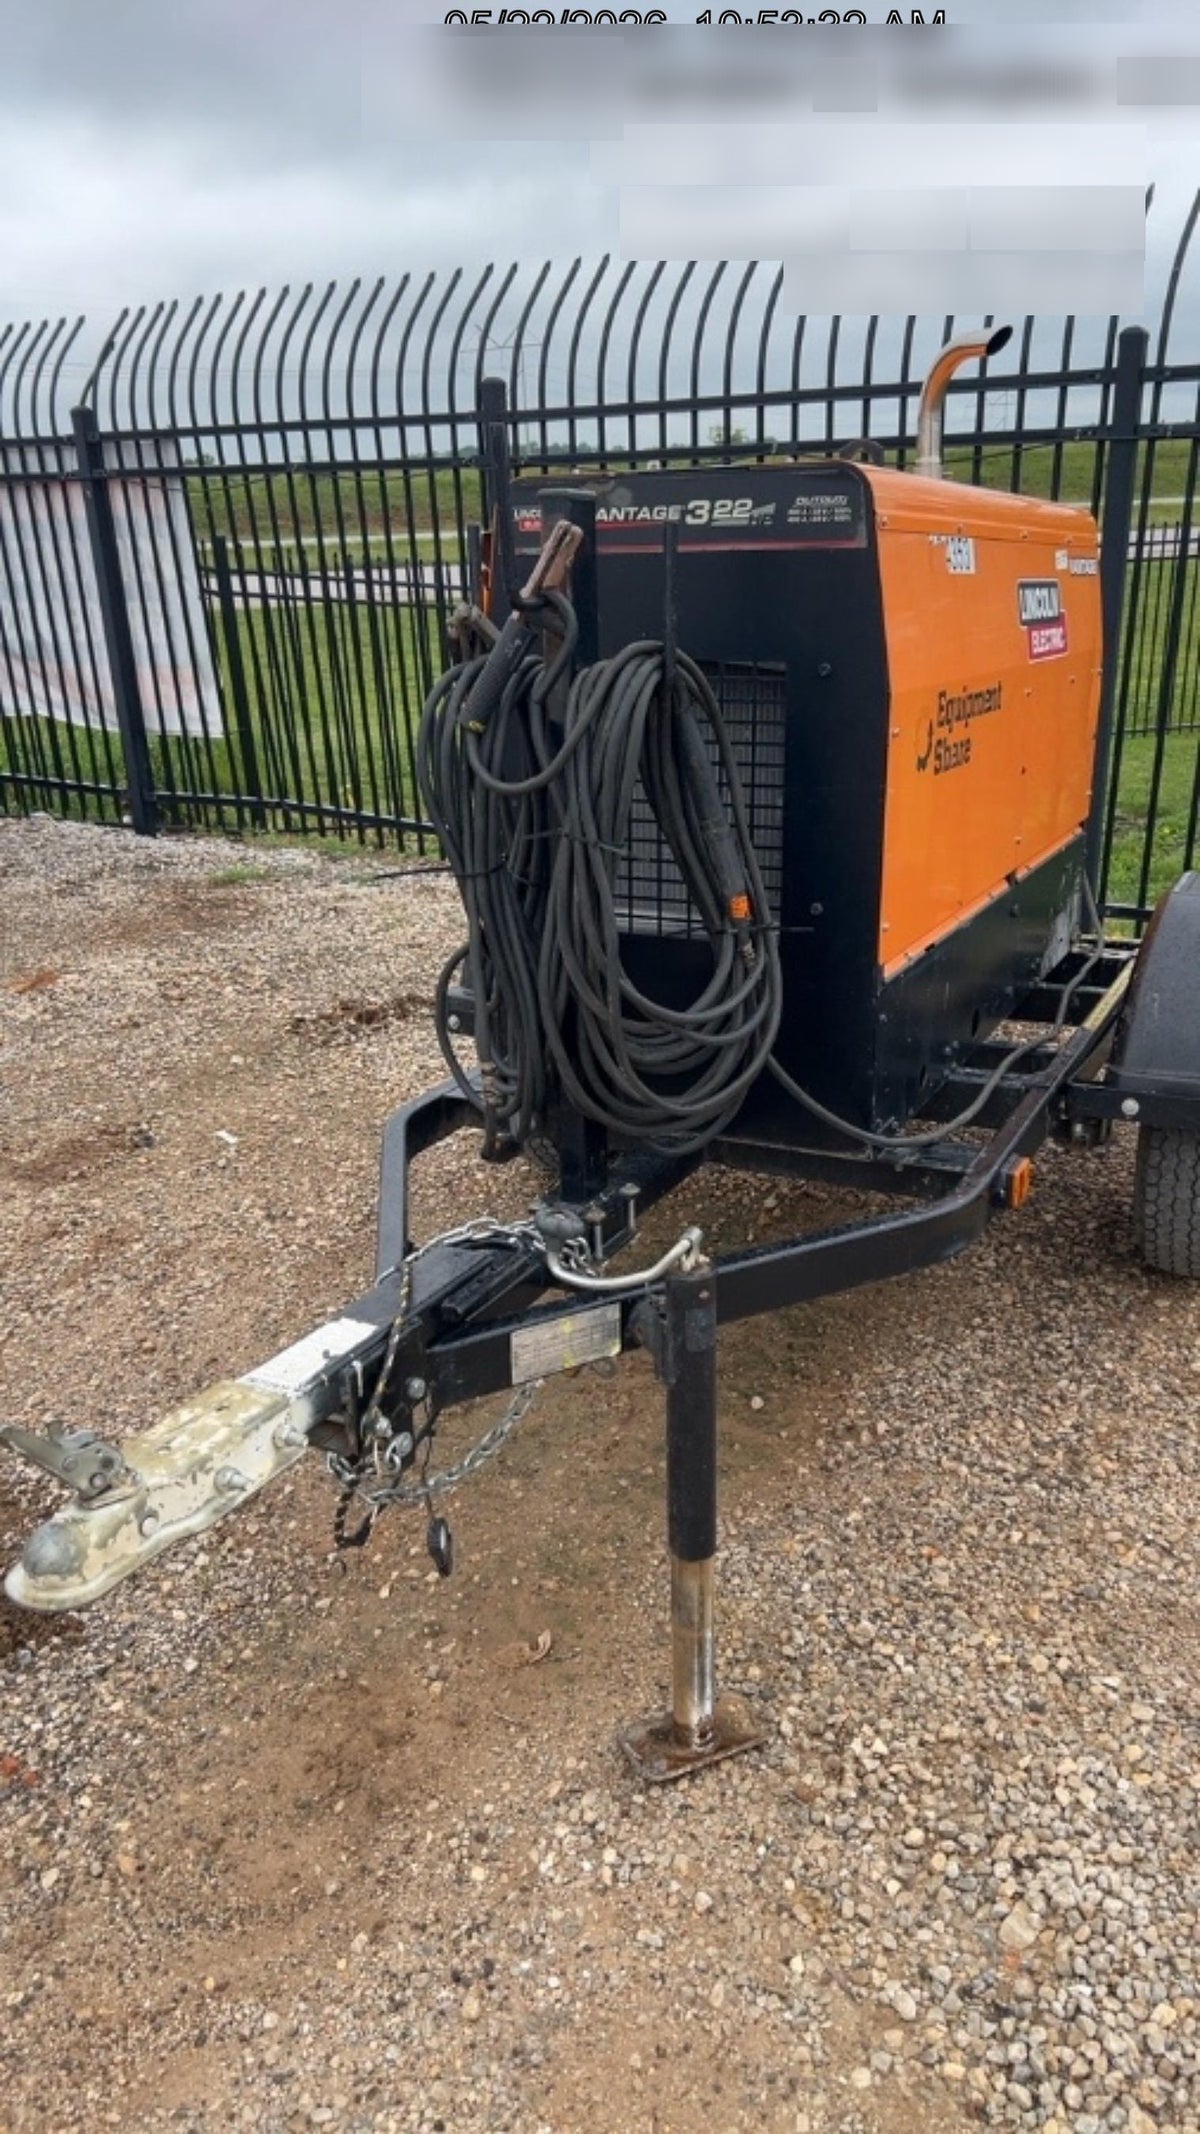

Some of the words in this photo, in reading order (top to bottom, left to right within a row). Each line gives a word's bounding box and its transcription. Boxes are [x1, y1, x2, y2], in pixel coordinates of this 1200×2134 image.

[595, 505, 682, 521] ANTAGE
[685, 498, 753, 525] 322
[1019, 587, 1059, 620] LINCOLN
[938, 680, 1002, 734] Equipment
[934, 737, 970, 776] Share
